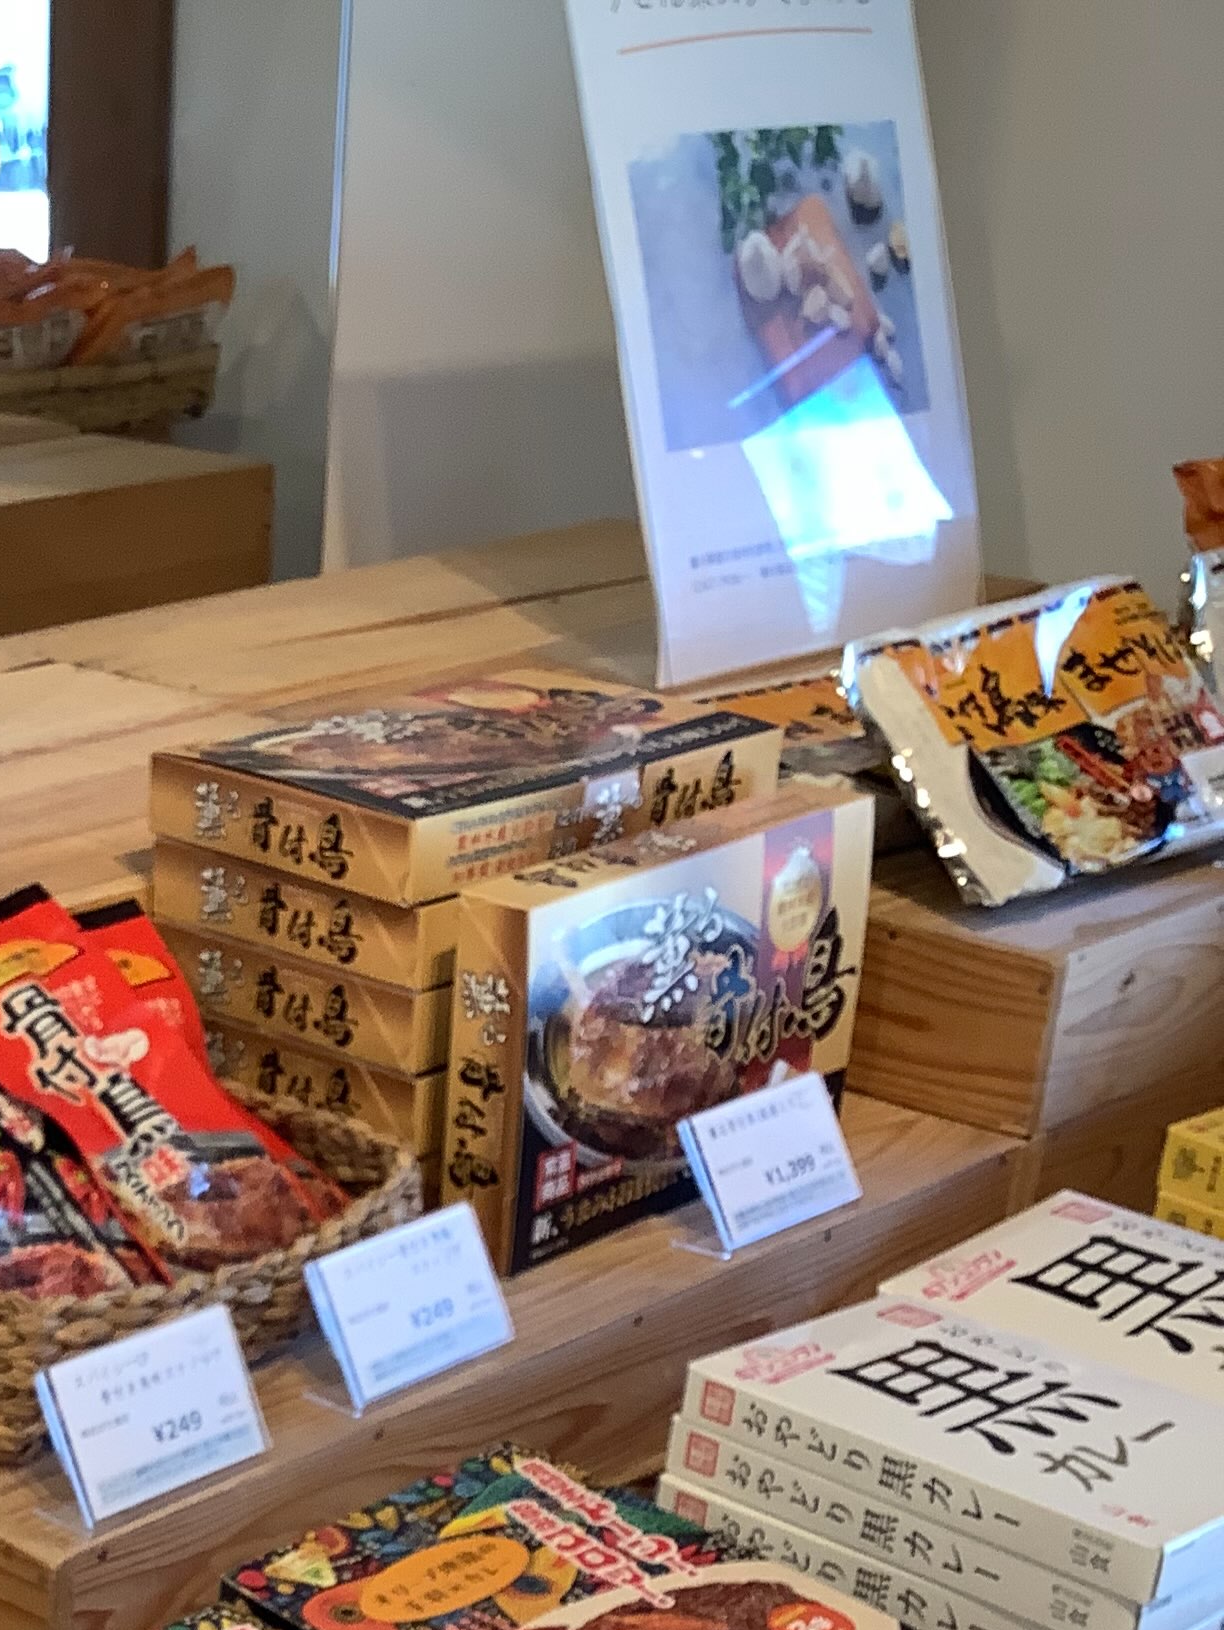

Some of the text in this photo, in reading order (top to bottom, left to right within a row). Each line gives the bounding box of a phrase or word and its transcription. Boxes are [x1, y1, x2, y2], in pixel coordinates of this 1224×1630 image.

[764, 1153, 816, 1185] ¥1,399
[151, 1410, 204, 1443] ¥249
[742, 1402, 1021, 1530] おやどり黒カレー
[726, 1453, 1002, 1582] おやどり黒カレー
